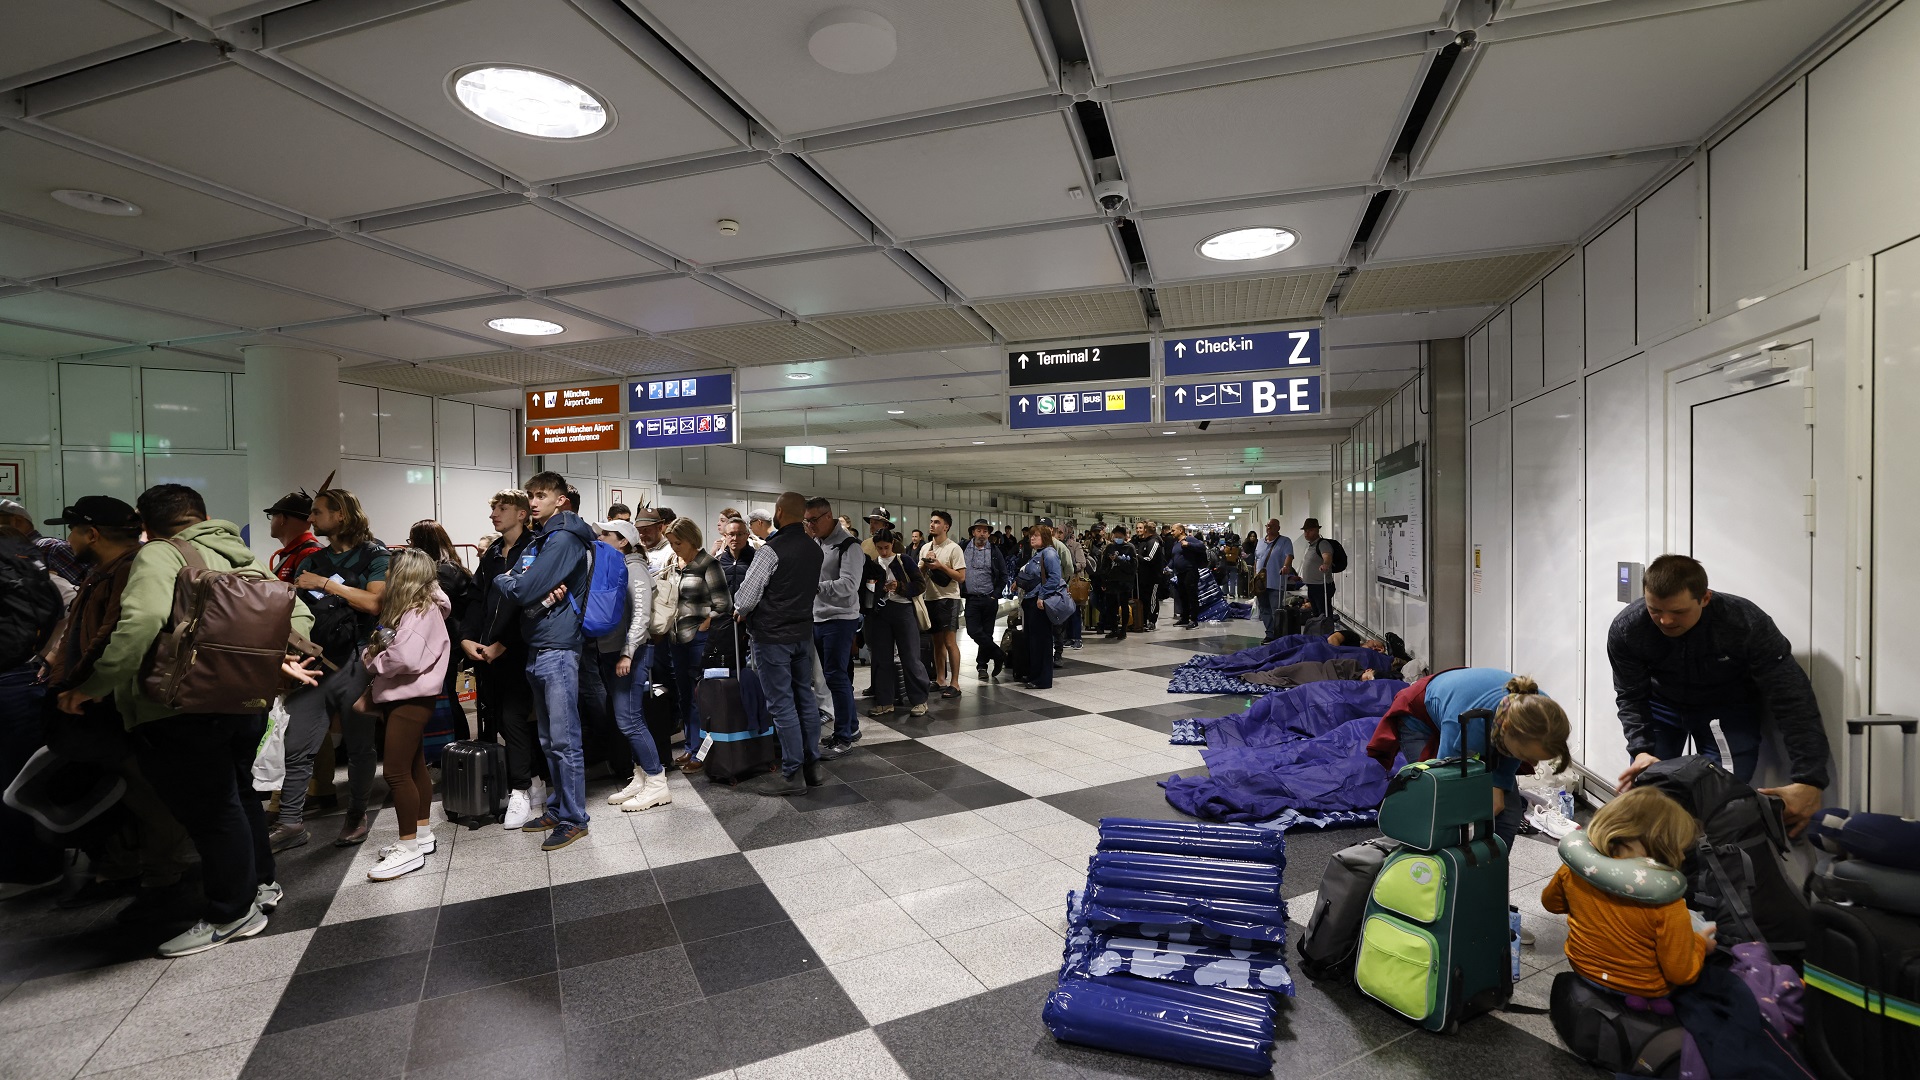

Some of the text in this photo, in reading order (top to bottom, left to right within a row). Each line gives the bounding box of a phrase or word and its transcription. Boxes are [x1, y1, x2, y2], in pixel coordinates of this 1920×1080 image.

[1195, 331, 1311, 365] Check-in Z
[1036, 348, 1101, 366] Terminal 2
[563, 389, 590, 399] München
[1083, 395, 1101, 403] BUS
[1107, 394, 1124, 402] TAXI
[1252, 378, 1310, 414] B-E
[563, 397, 604, 408] Airport Center
[544, 423, 614, 435] Novotel München Airport
[544, 433, 600, 443] municon conference
